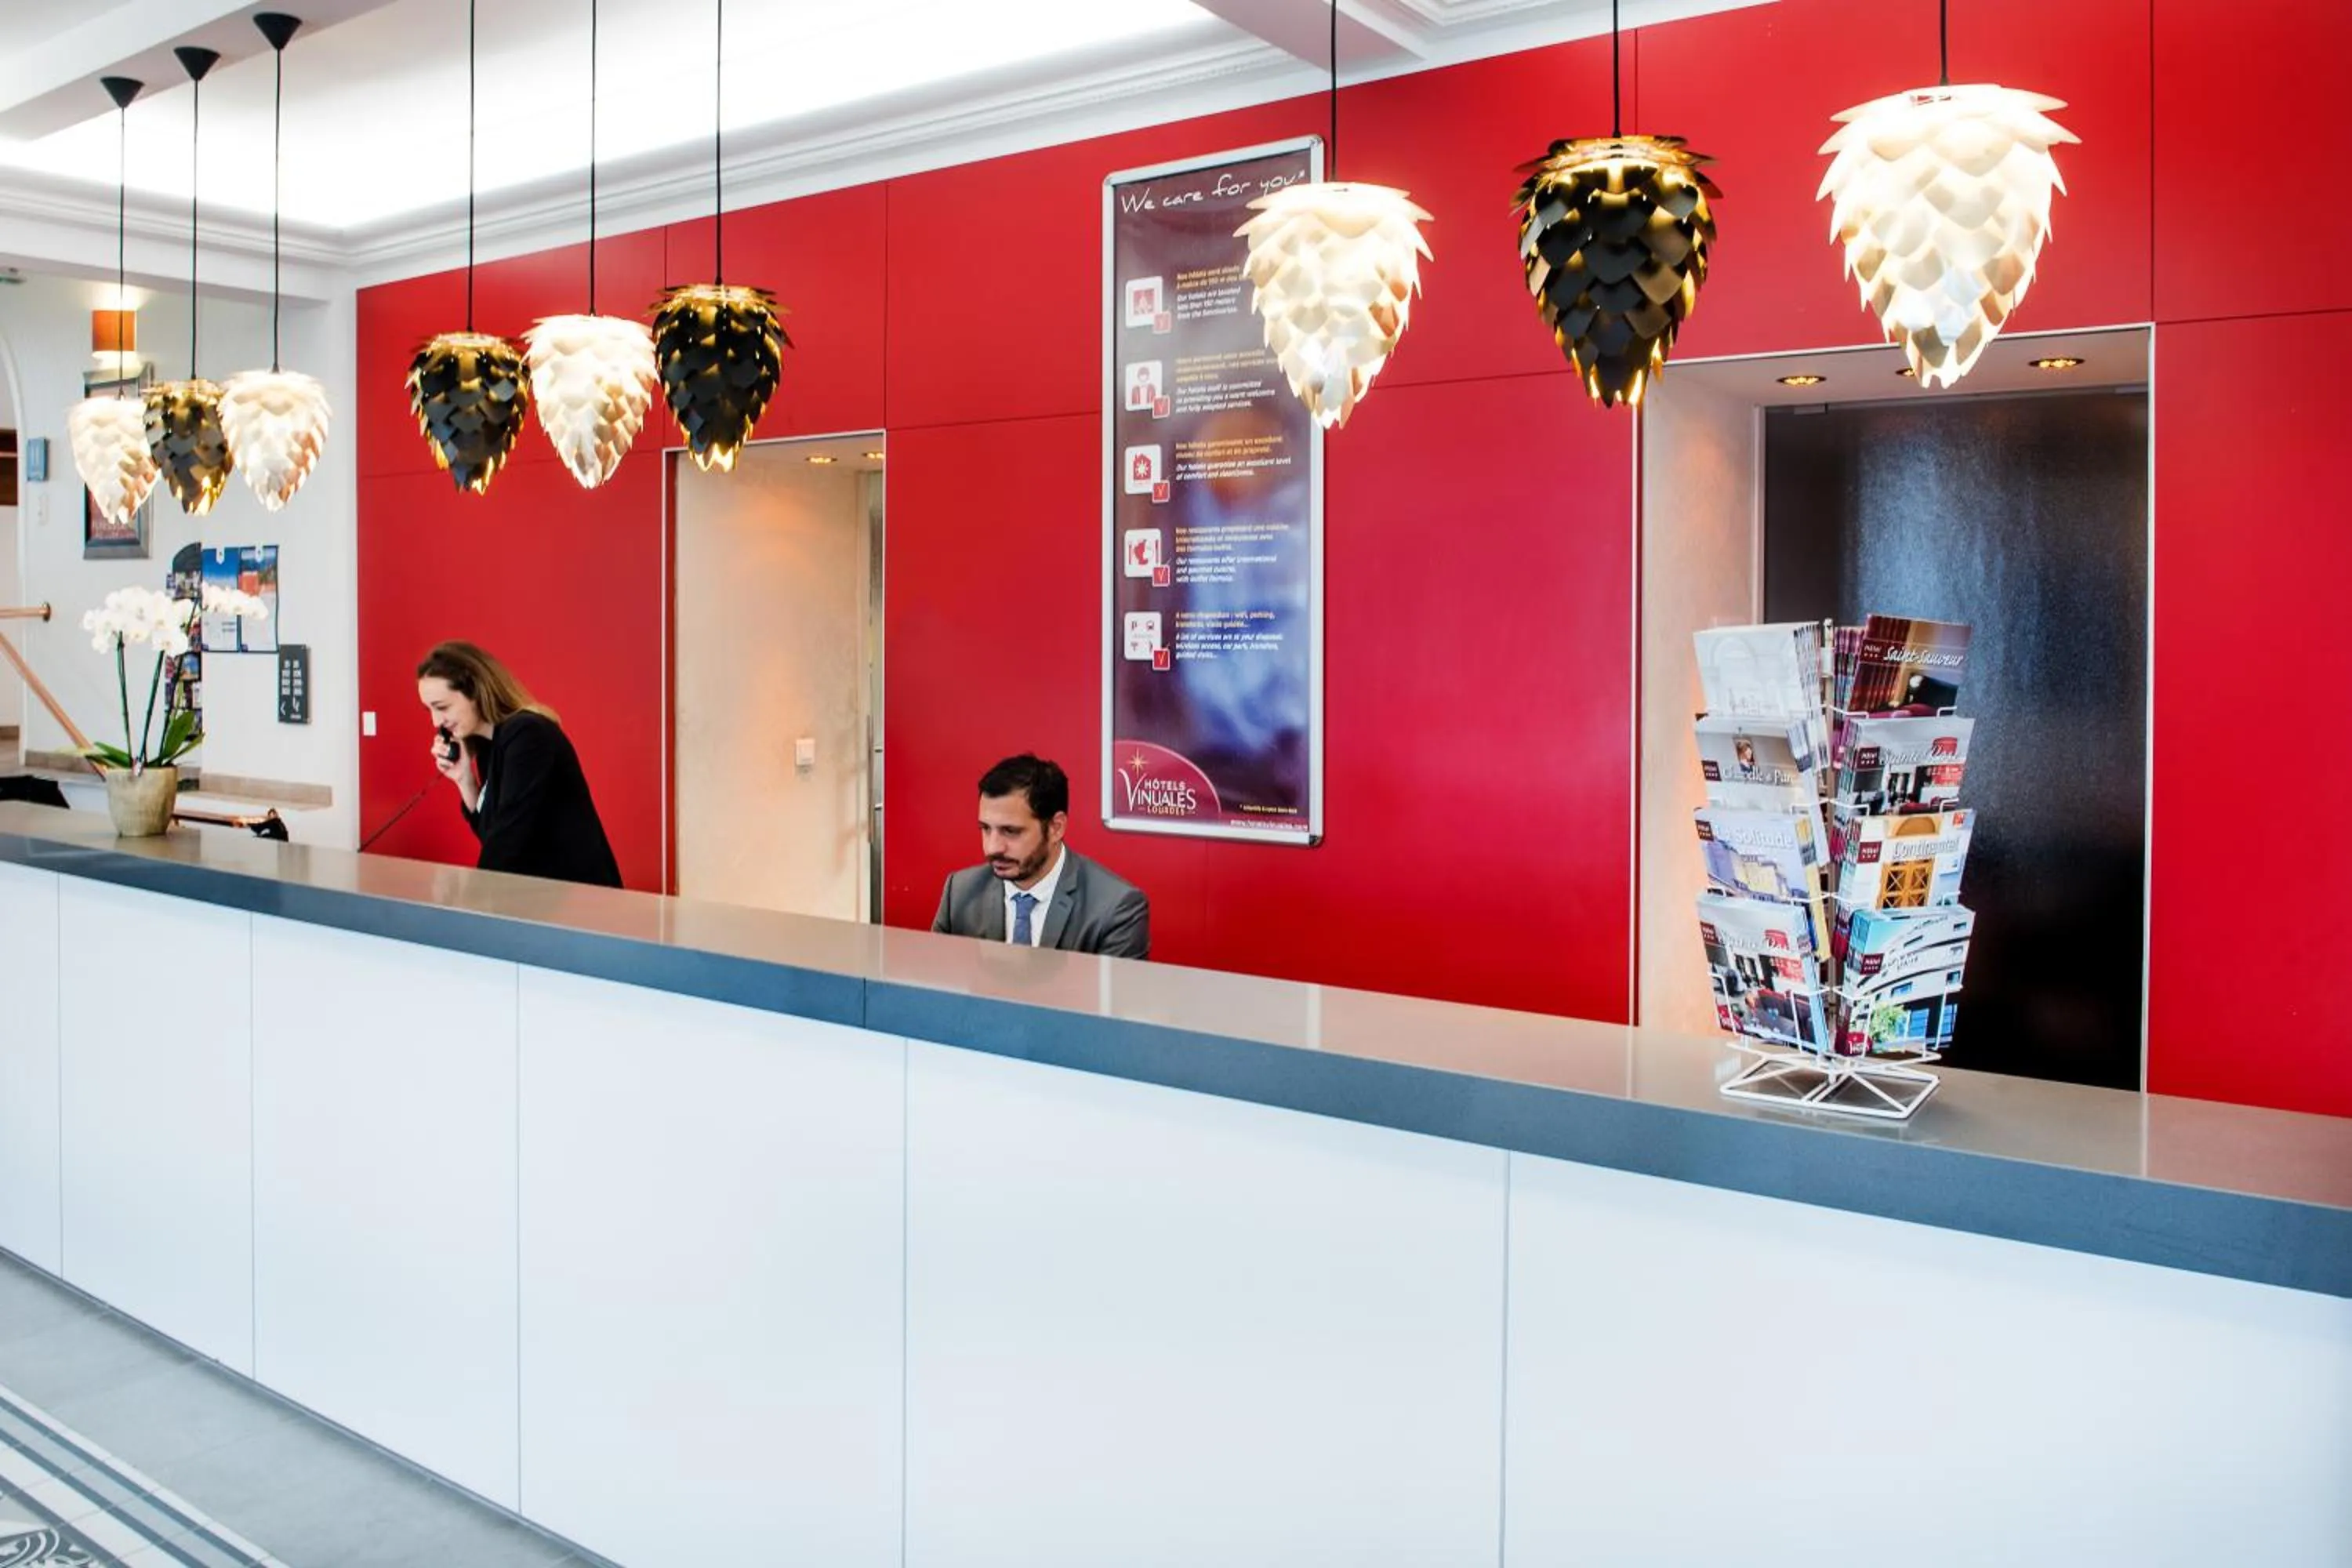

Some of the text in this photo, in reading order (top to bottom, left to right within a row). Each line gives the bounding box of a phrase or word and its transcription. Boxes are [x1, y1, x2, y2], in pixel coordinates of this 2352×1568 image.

[1121, 188, 1155, 213] We
[1163, 191, 1203, 207] care
[1211, 173, 1251, 197] for
[1883, 645, 1964, 666] Saint-Sauveur
[1118, 768, 1197, 812] VINUALES
[1145, 777, 1186, 791] HÔTELS
[1147, 805, 1185, 817] LOURDES
[1736, 826, 1794, 850] Solitude
[1893, 837, 1961, 860] Continental
